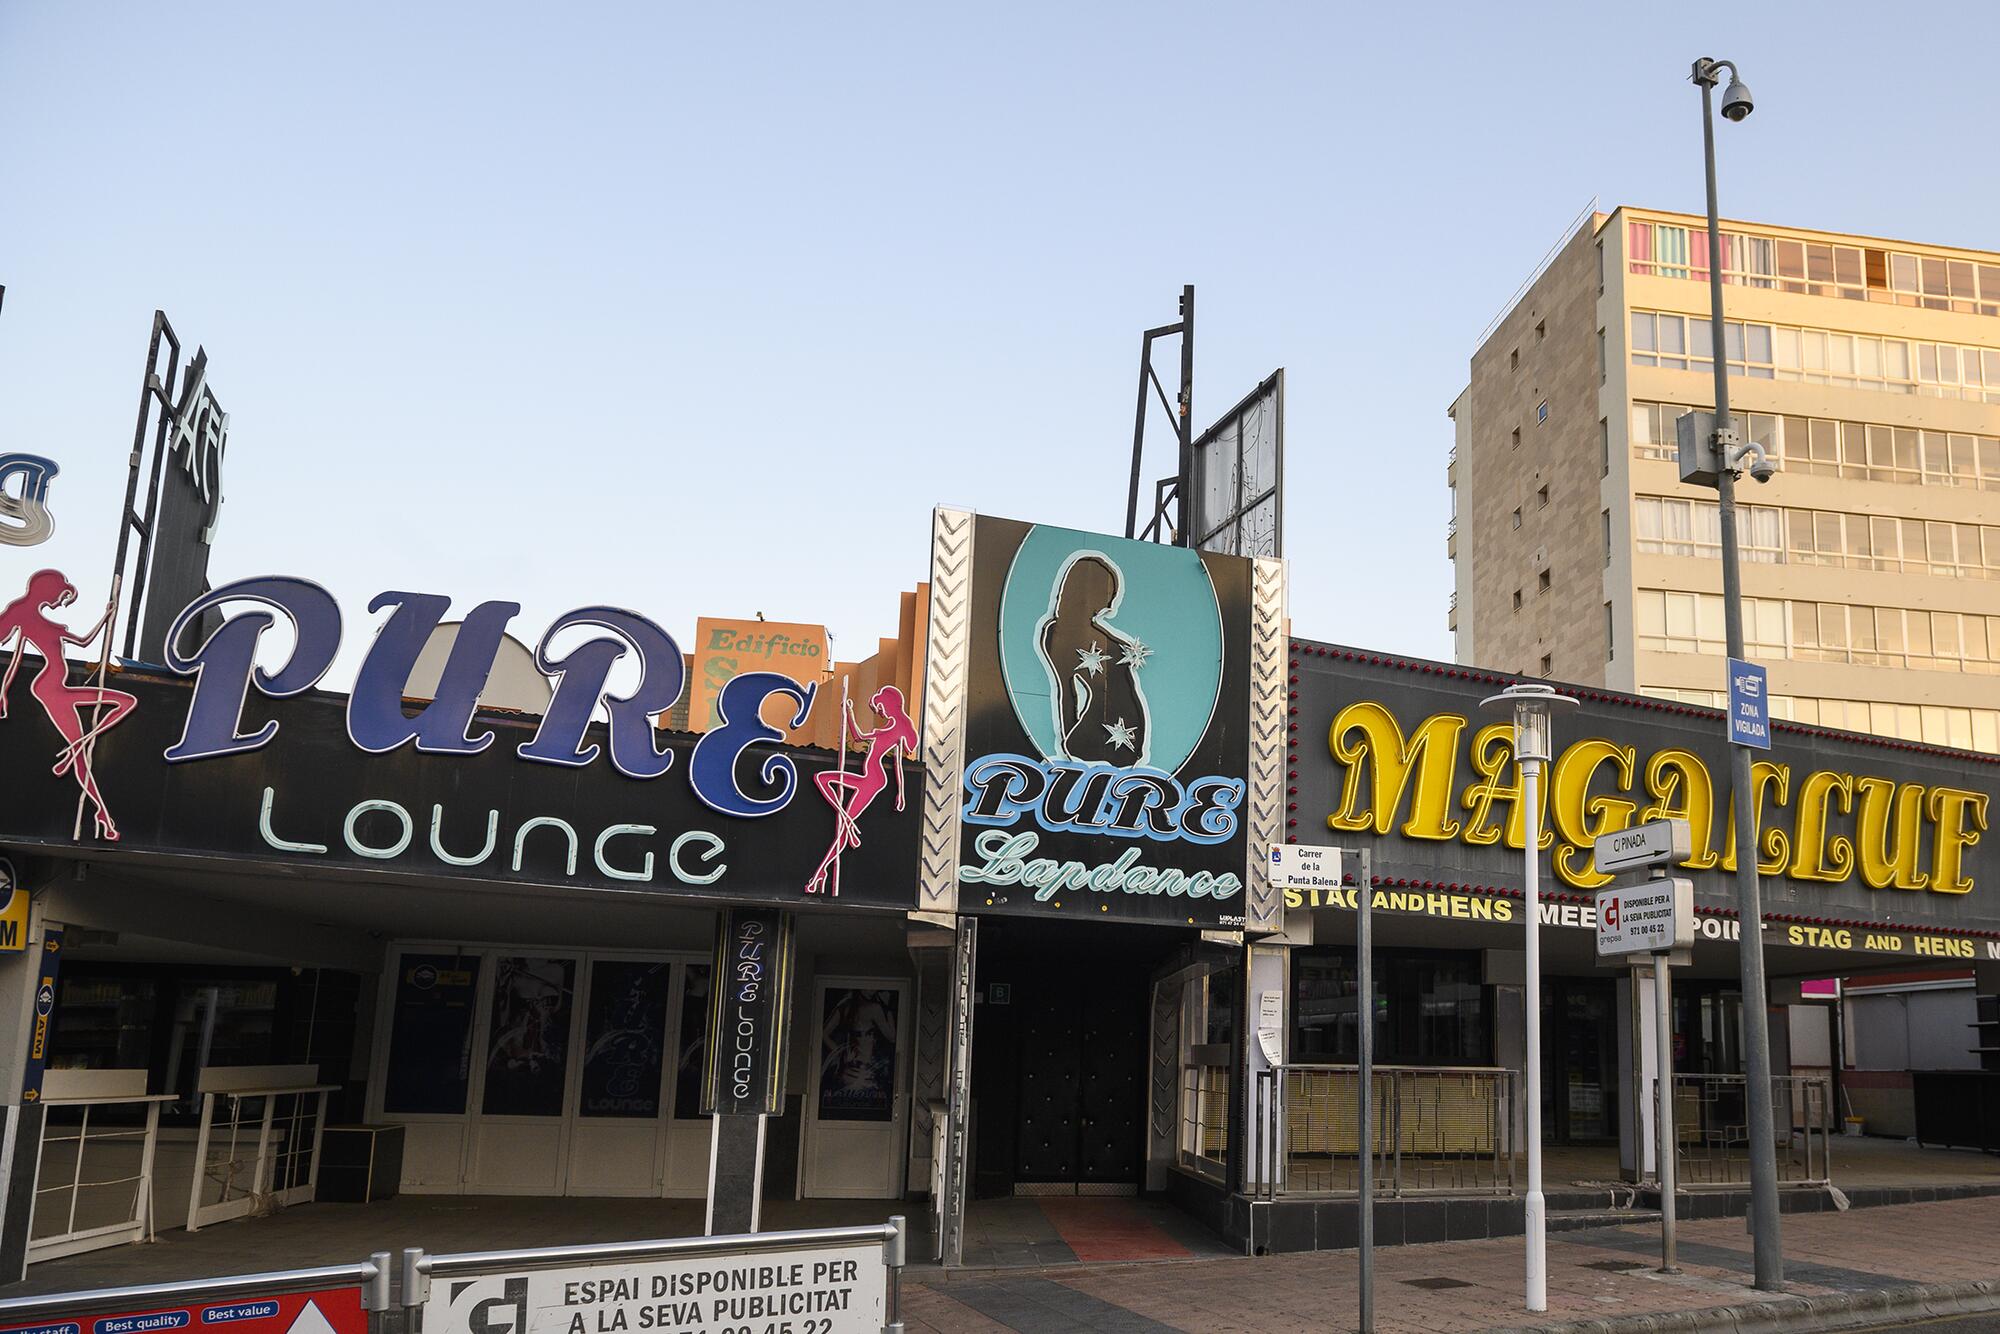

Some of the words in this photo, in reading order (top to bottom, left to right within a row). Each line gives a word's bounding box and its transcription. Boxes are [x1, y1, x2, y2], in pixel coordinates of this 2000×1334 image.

[706, 628, 821, 659] Edificio
[163, 574, 818, 818] PURE
[1740, 702, 1759, 719] ZONA
[1735, 719, 1766, 738] VIGILADA
[962, 753, 1247, 846] PURE
[1326, 700, 1990, 896] MAGALLUF
[1298, 848, 1323, 858] Carrer
[1621, 834, 1646, 850] PINADA
[958, 829, 1243, 902] Lapdance
[1301, 862, 1311, 871] de
[1313, 862, 1320, 871] la
[1287, 874, 1310, 885] Punta
[1312, 876, 1338, 886] Balena
[1622, 915, 1629, 923] LA
[1630, 912, 1643, 921] SEVA
[1643, 908, 1672, 920] PUBLICITAT
[1623, 896, 1654, 909] DISPONIBLE
[1654, 895, 1665, 905] PER
[1664, 894, 1670, 903] A
[1599, 935, 1622, 946] grepsa
[1630, 926, 1640, 936] 971
[1649, 924, 1656, 933] 45
[1657, 923, 1665, 933] 22
[1788, 925, 1853, 950] STAG
[1864, 934, 1902, 951] AND
[1914, 936, 1976, 958] HENS
[736, 920, 765, 1003] PURE
[34, 1018, 45, 1055] ATM
[564, 1277, 640, 1306] ESPAI
[651, 1264, 804, 1298] DISPONIBLE
[813, 1260, 858, 1285] PER
[105, 1321, 133, 1333] Best
[137, 1314, 182, 1331] quality
[208, 1309, 234, 1321] Best
[238, 1305, 271, 1317] value
[568, 1311, 586, 1334] A
[638, 1301, 703, 1329] SEVA
[713, 1288, 853, 1322] PUBLICITAT
